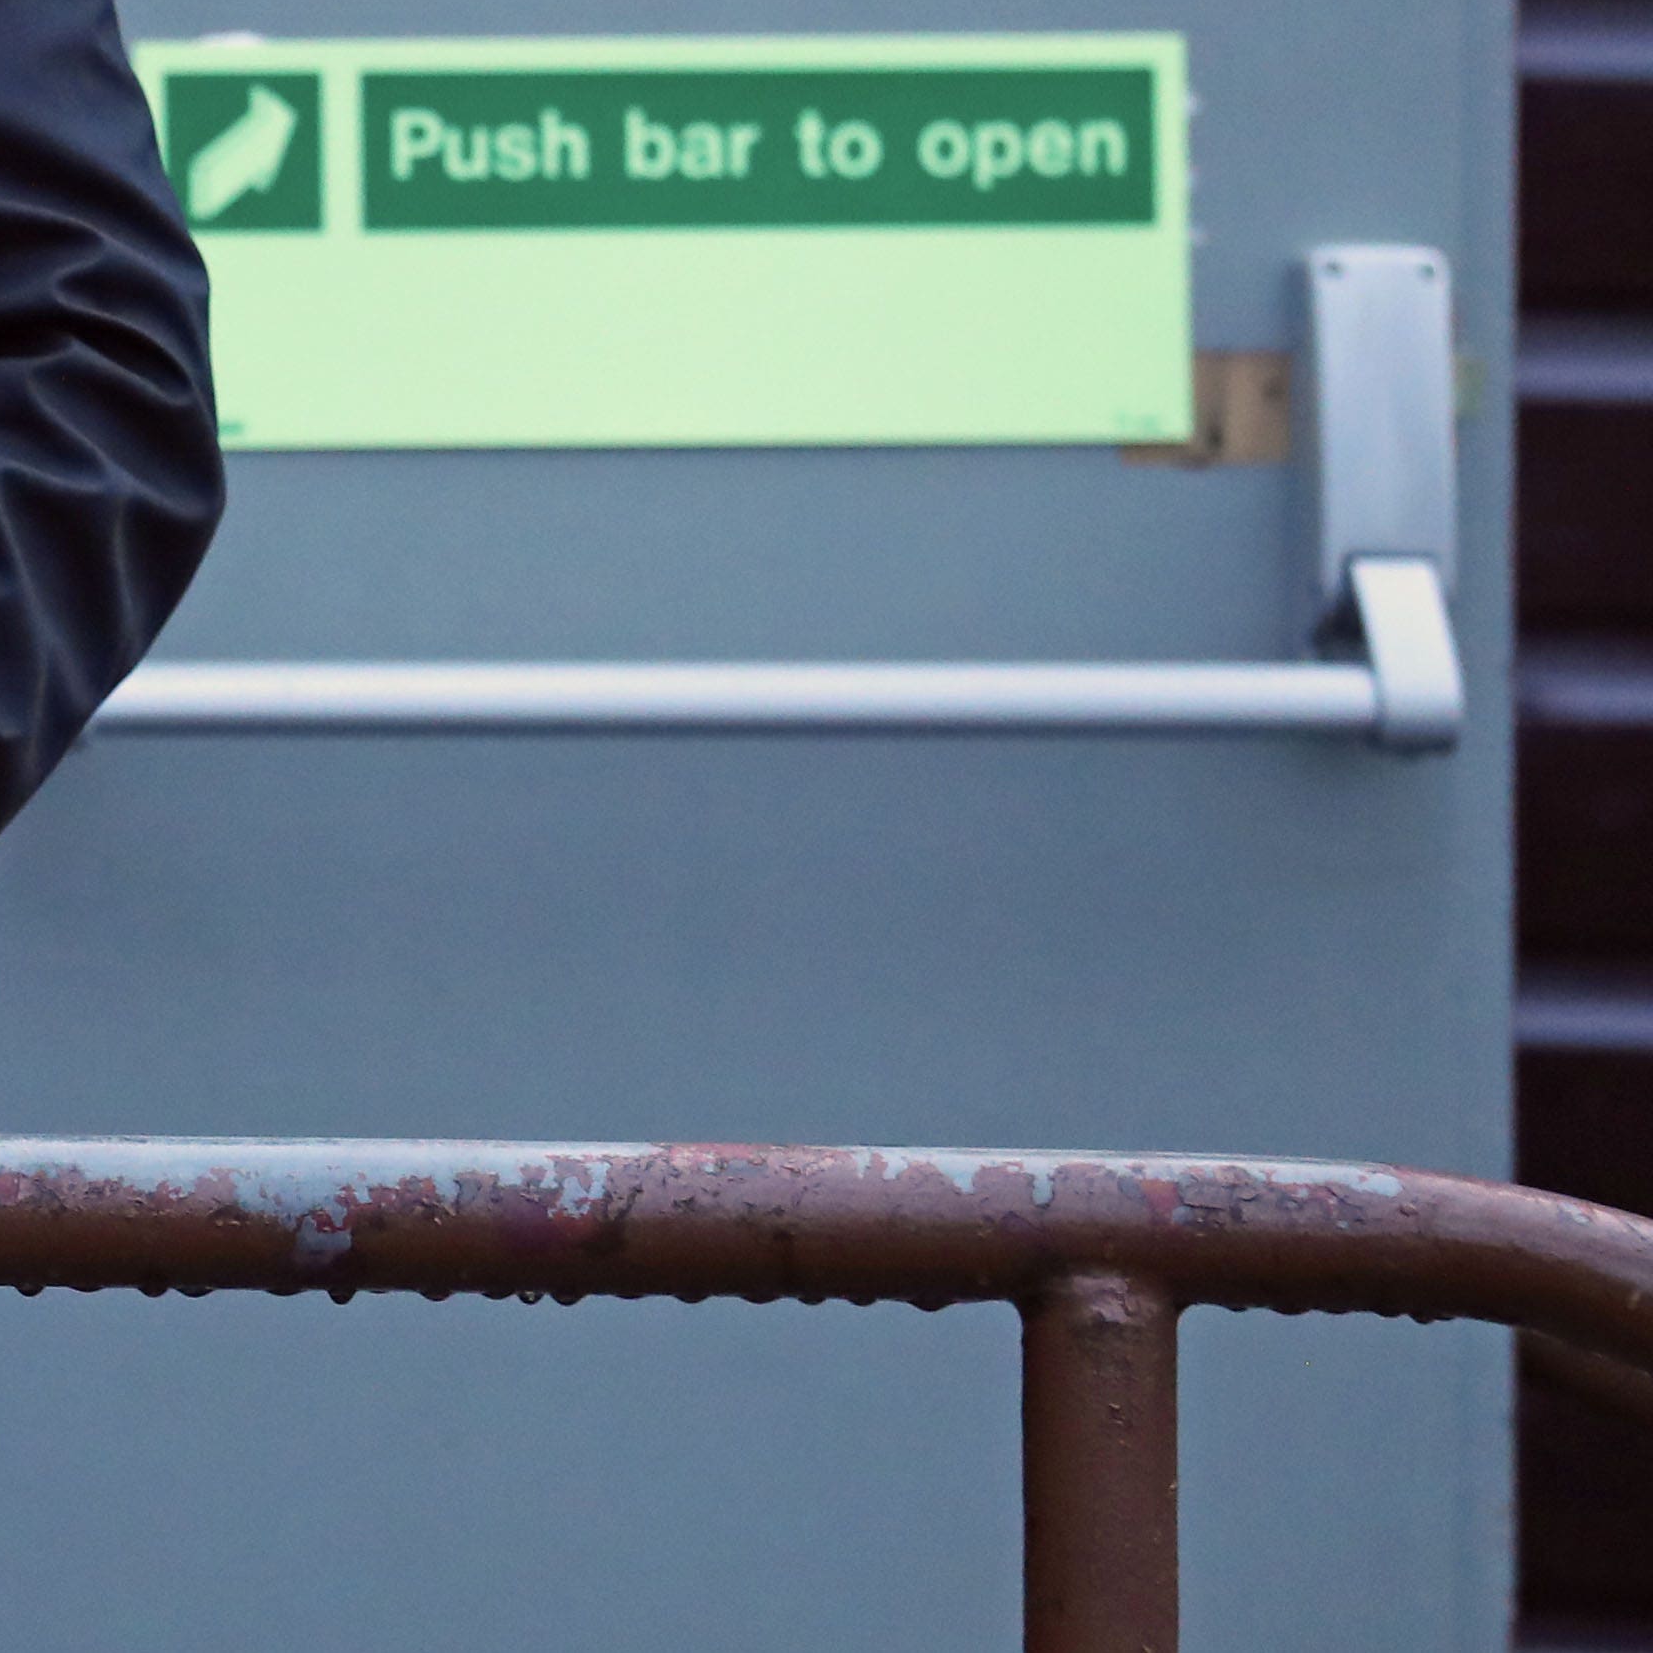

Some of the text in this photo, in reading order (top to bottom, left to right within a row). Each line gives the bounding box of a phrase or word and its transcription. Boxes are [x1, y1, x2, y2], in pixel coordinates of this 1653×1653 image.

[390, 107, 1128, 190] Push bar to open
